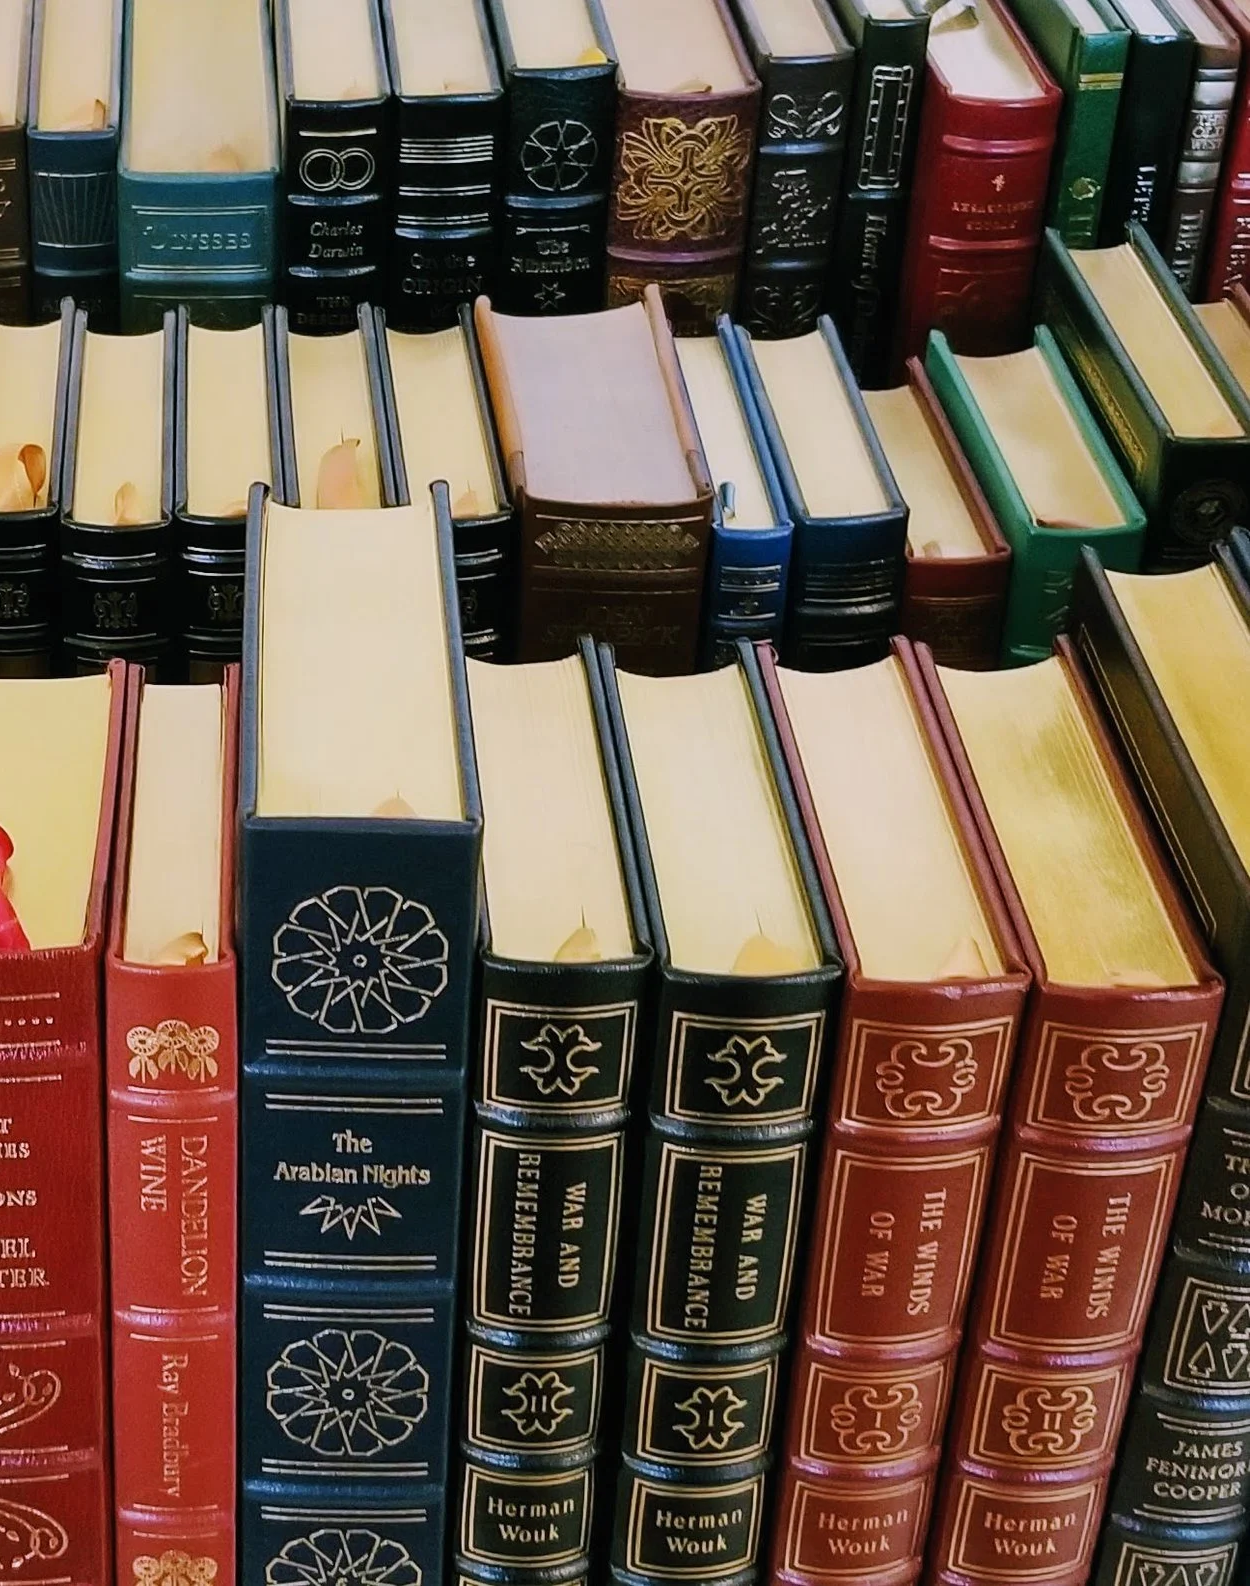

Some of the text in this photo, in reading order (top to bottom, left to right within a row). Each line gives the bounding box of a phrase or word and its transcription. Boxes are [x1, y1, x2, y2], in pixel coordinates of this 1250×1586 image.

[143, 225, 252, 250] ULYSSES
[310, 221, 363, 238] Charles
[309, 241, 363, 259] Darwin
[402, 275, 483, 295] ORIGIN
[332, 1130, 373, 1154] The
[139, 1135, 168, 1213] WINE
[273, 1161, 431, 1188] Arabian Nights
[181, 1135, 209, 1296] DANDELION
[508, 1152, 541, 1317] REMEMBRANCE
[558, 1181, 588, 1289] WAR AND
[683, 1164, 723, 1330] REMEMBRANCE
[735, 1193, 768, 1301] WAR AND
[860, 1211, 896, 1299] OF WAR
[906, 1187, 948, 1317] THE WINDS
[1040, 1214, 1078, 1301] OF WAR
[1085, 1192, 1132, 1321] THE WINDS
[156, 1353, 190, 1498] Ray Bradbury
[1173, 1439, 1244, 1460] JAMES
[1153, 1481, 1242, 1502] COOPER
[487, 1496, 576, 1518] Herman
[655, 1507, 744, 1530] Herman
[498, 1523, 560, 1543] Wouk
[818, 1508, 909, 1533] Herman
[983, 1510, 1077, 1535] Herman
[665, 1533, 728, 1556] Wouk
[828, 1532, 891, 1557] Wouk
[994, 1536, 1058, 1558] Wouk
